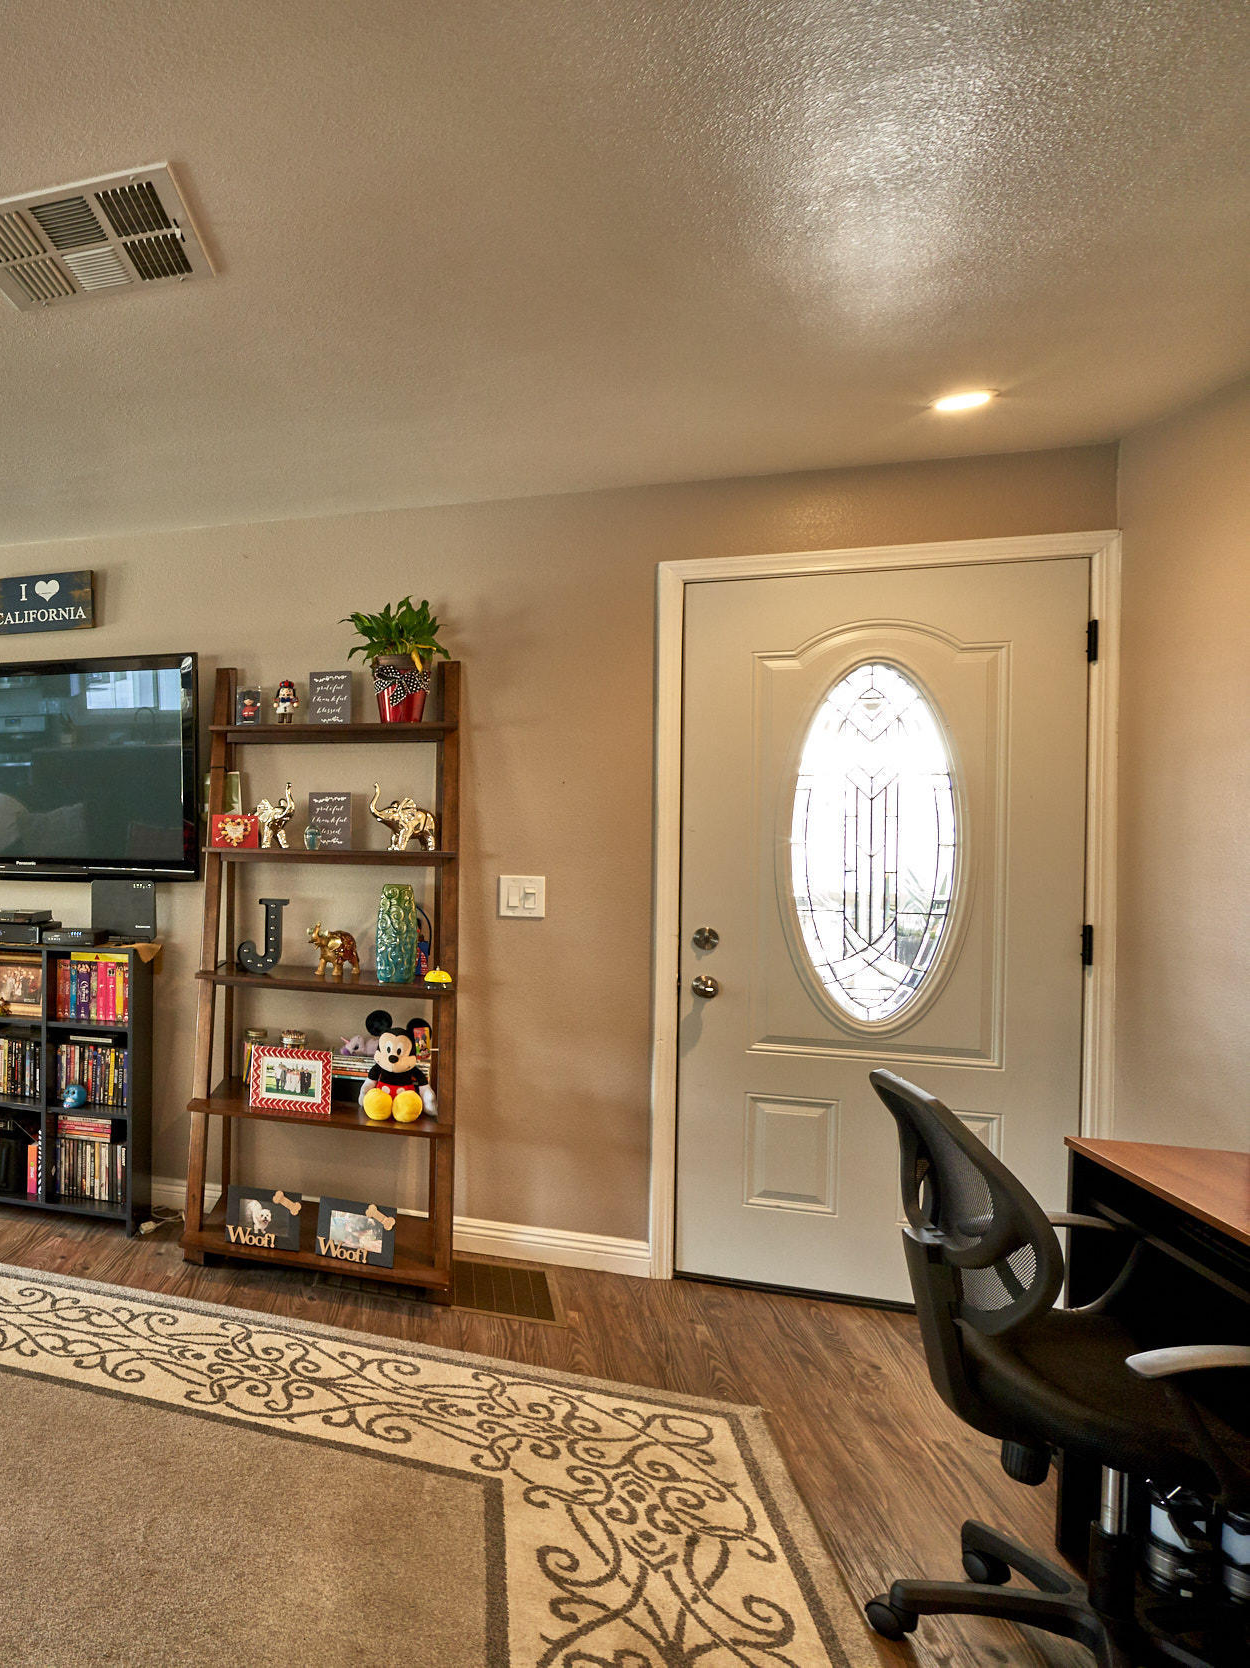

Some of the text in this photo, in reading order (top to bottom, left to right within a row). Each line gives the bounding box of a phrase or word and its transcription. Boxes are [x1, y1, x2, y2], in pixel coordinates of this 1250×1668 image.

[20, 584, 28, 602] I
[316, 684, 344, 693] grateful
[312, 695, 348, 704] thankful
[316, 706, 342, 714] blessed
[316, 805, 344, 814] grateful
[311, 816, 348, 826] thankful
[237, 898, 290, 974] J
[226, 1224, 276, 1249] Woof!
[316, 1236, 368, 1264] Woof!
